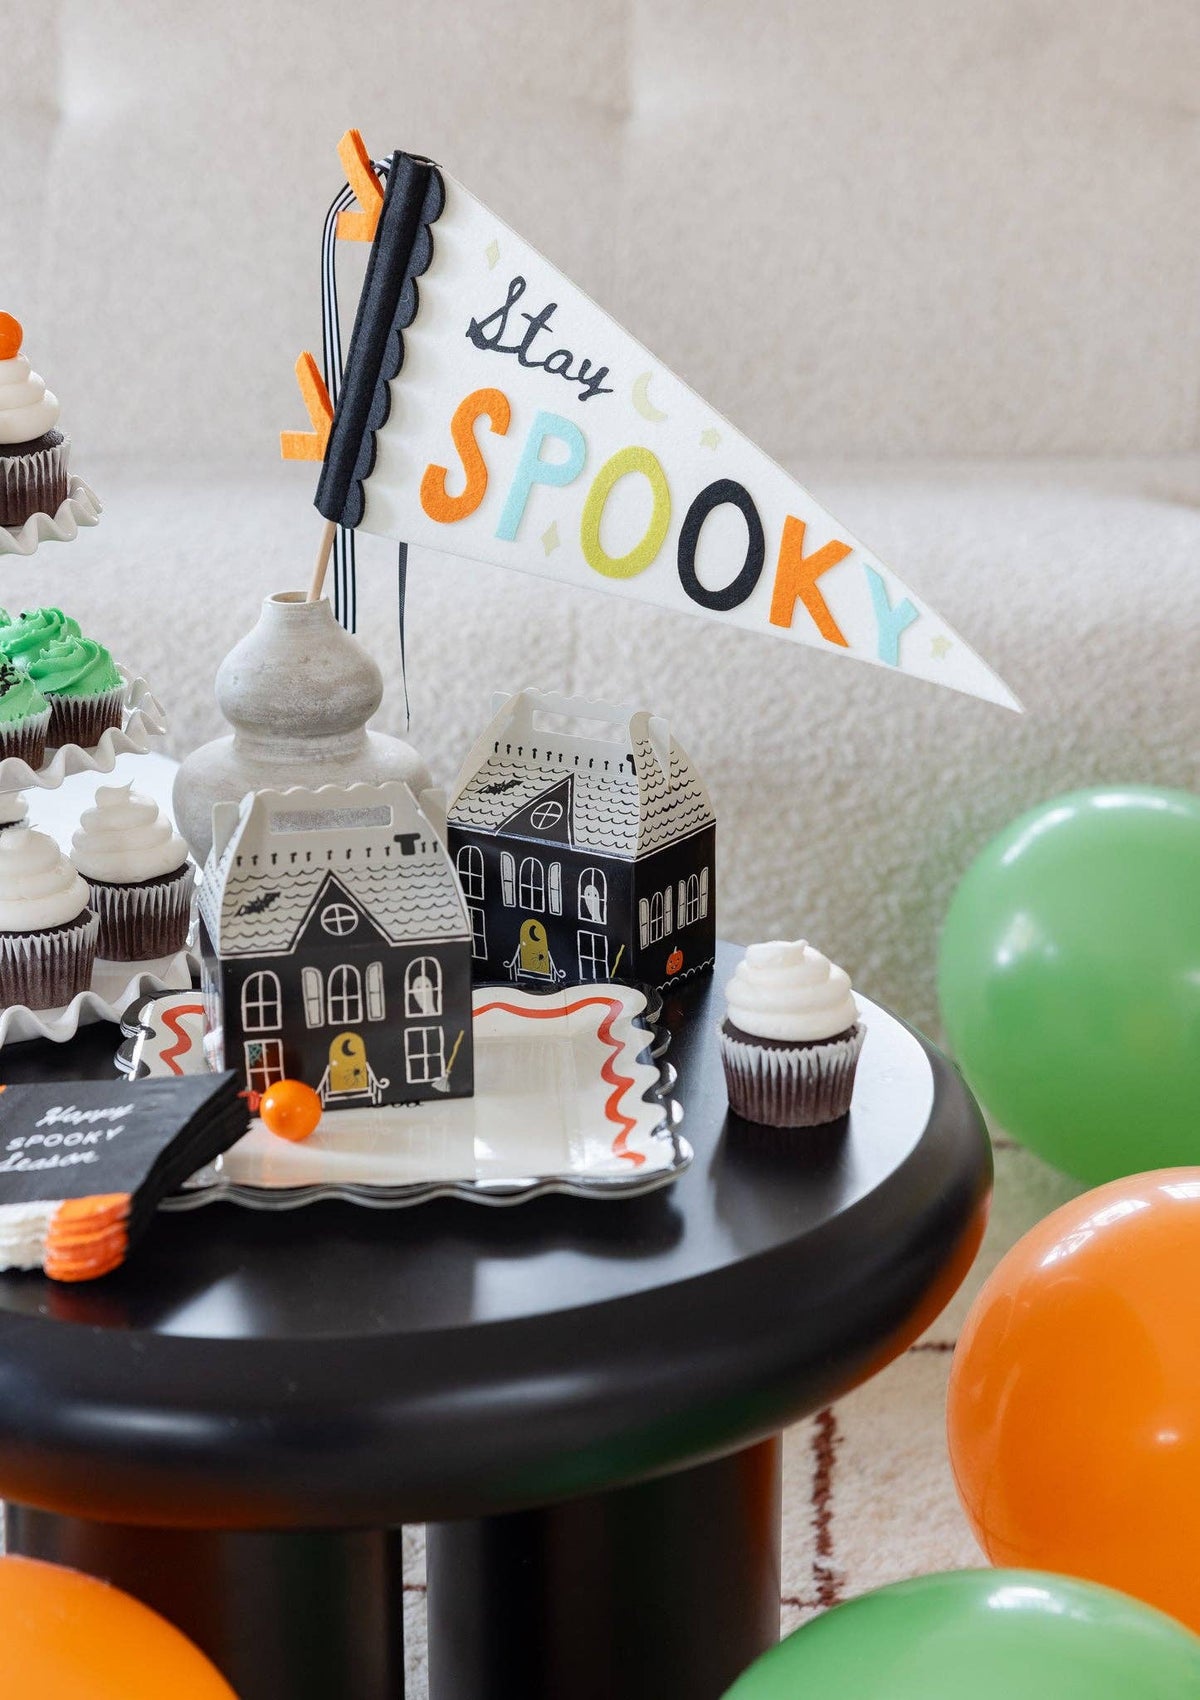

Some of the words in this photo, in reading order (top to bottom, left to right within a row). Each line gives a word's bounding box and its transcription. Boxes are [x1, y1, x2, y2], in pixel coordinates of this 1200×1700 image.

[466, 275, 614, 402] Stay
[419, 387, 920, 667] SPOOKY
[5, 1125, 126, 1151] SPOOKY
